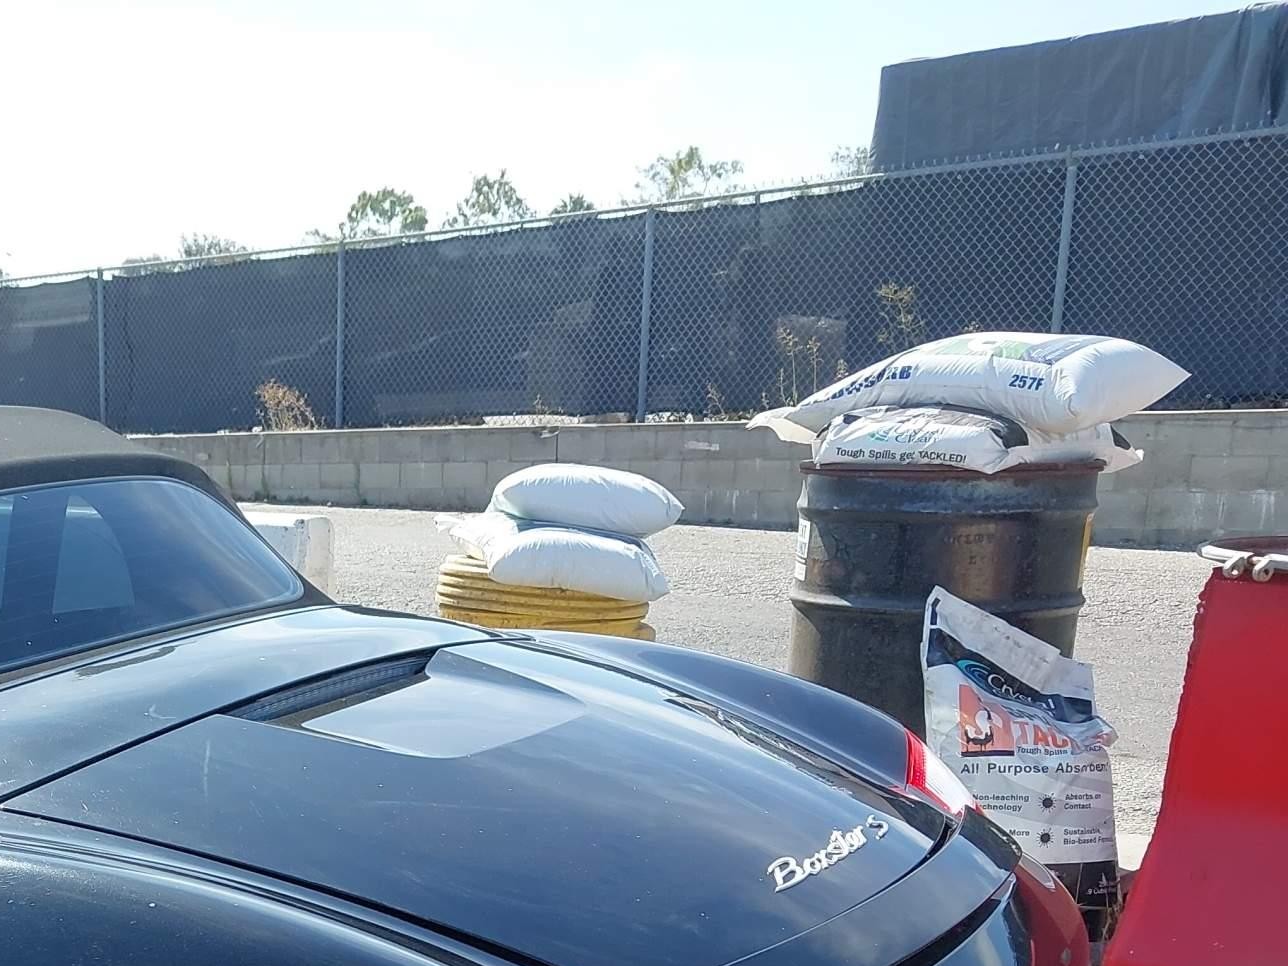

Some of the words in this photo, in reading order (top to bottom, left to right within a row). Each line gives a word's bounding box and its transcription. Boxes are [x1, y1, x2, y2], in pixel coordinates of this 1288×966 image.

[1009, 374, 1045, 391] 257F
[835, 447, 865, 459] Tough
[868, 449, 897, 461] Spills
[918, 450, 967, 464] TACKLED!
[1016, 746, 1042, 755] Tough
[961, 763, 979, 774] All
[987, 763, 1049, 776] Purpose
[972, 794, 1030, 803] Non-leaching
[982, 804, 1023, 812] chnology
[1064, 837, 1097, 845] Bio-based
[767, 825, 868, 893] Boxster
[866, 814, 889, 840] S
